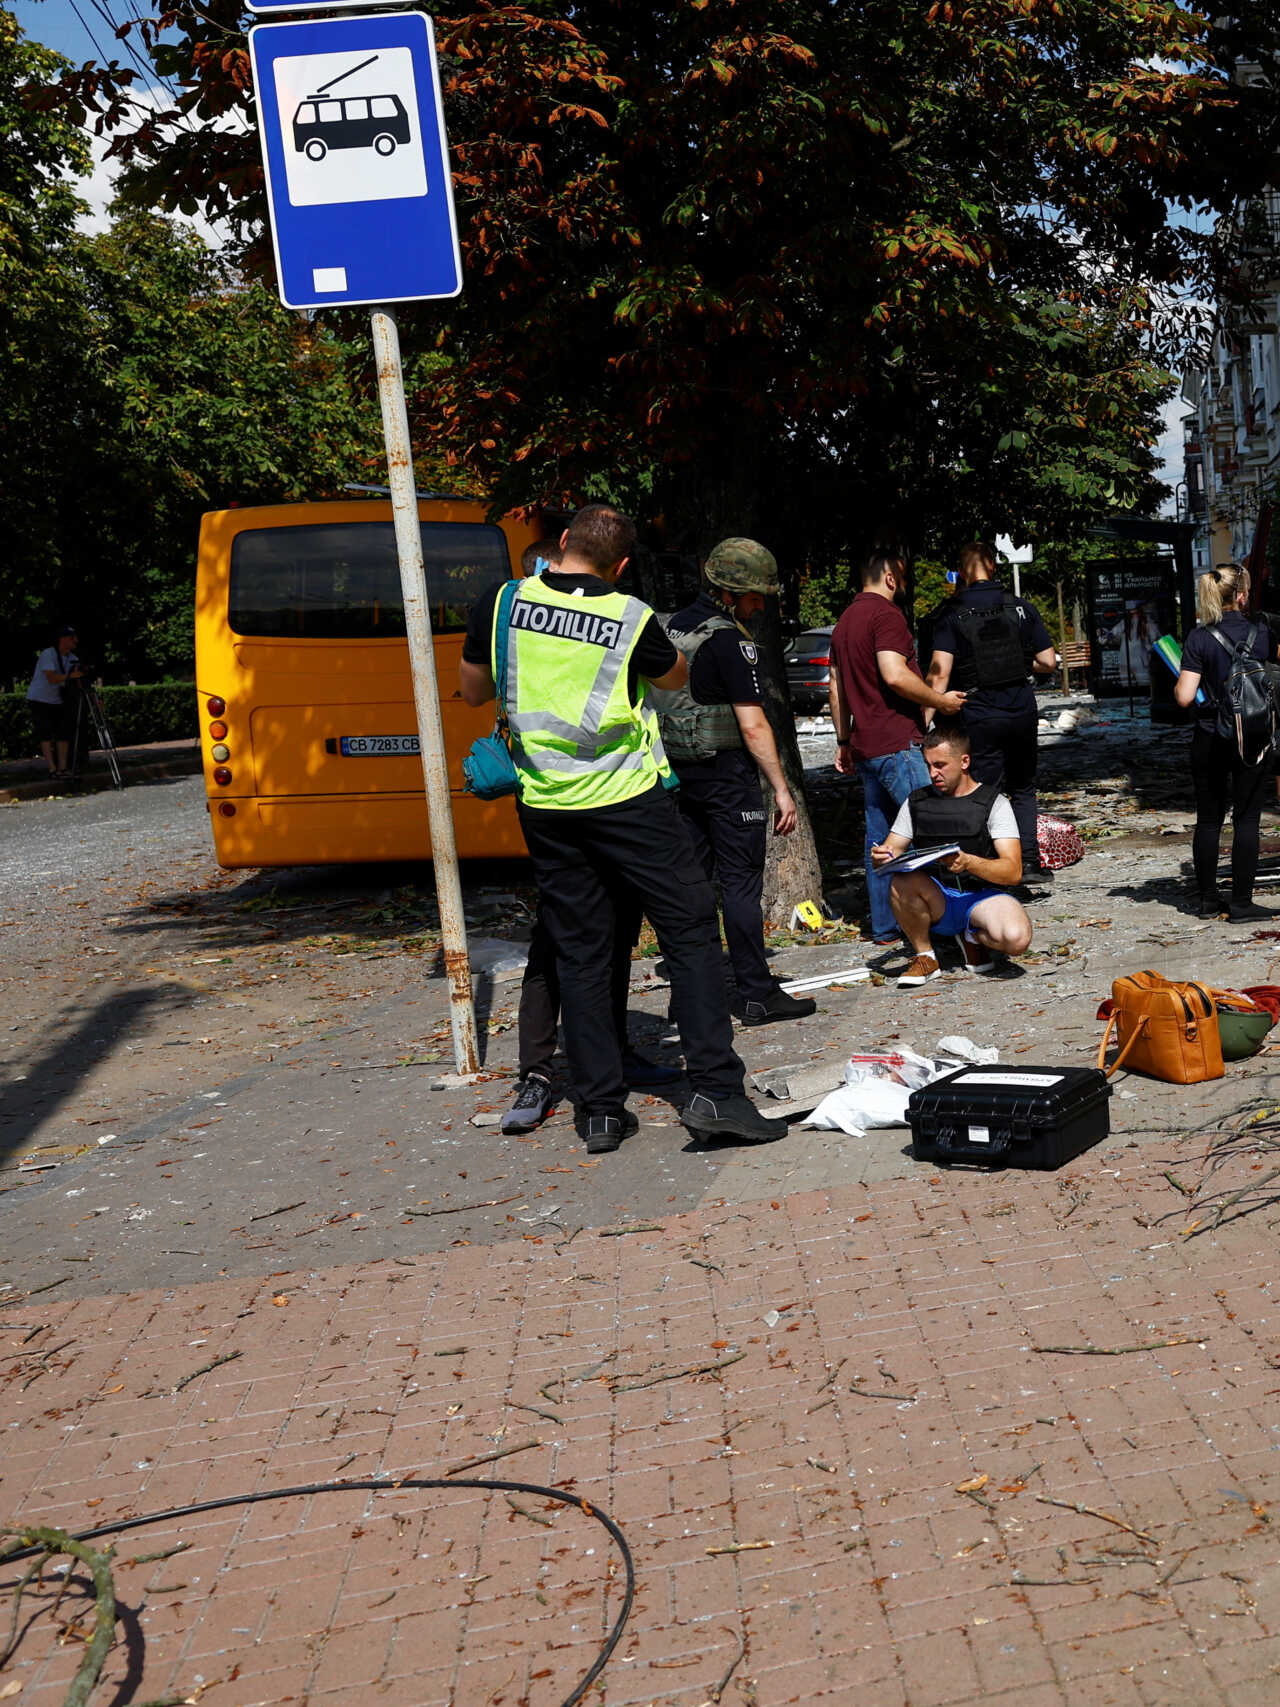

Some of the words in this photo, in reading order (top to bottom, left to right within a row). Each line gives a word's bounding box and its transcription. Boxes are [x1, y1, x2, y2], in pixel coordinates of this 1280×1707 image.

[511, 602, 621, 648] ПОЛІЦІЯ
[350, 739, 367, 751] CB
[370, 739, 399, 751] 7283
[806, 906, 814, 916] 4
